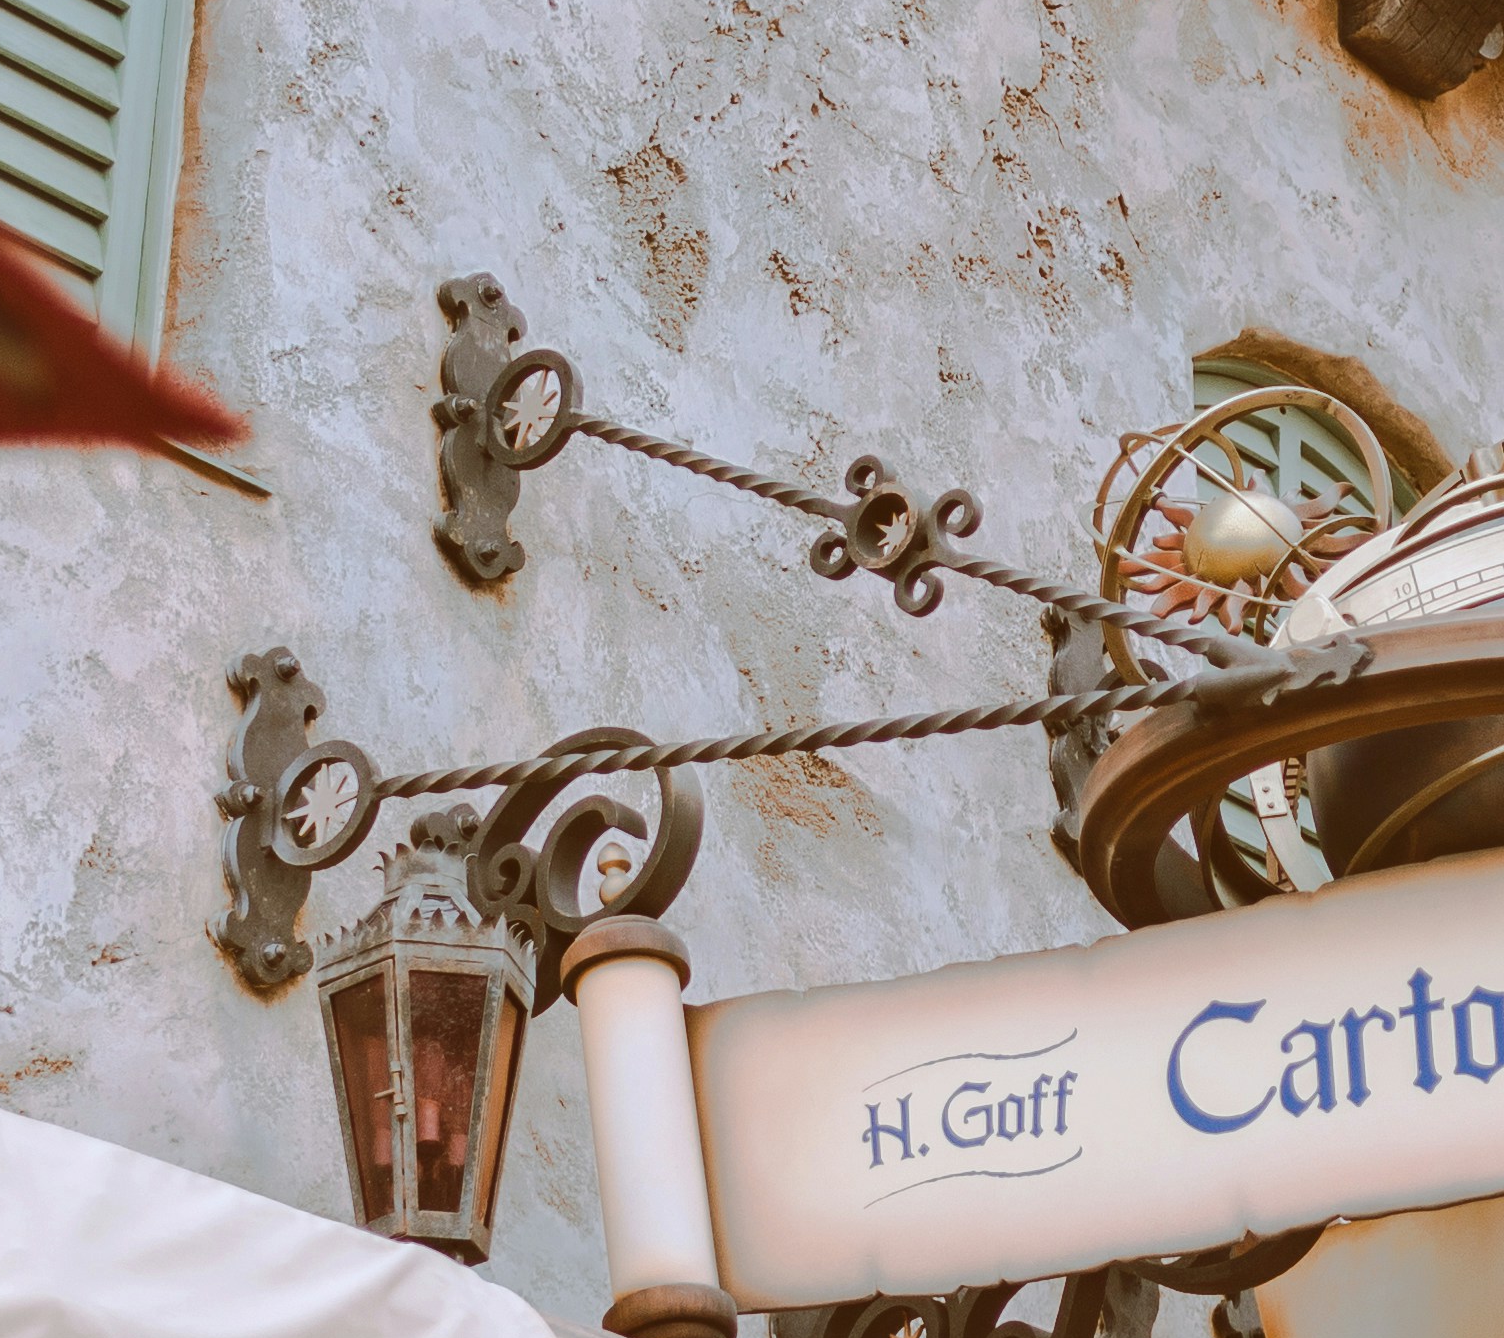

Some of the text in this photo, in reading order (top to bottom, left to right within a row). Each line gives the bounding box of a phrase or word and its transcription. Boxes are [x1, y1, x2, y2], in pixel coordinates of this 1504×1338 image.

[1393, 582, 1413, 599] 10
[861, 1091, 931, 1170] H.
[941, 1069, 1079, 1149] Goff
